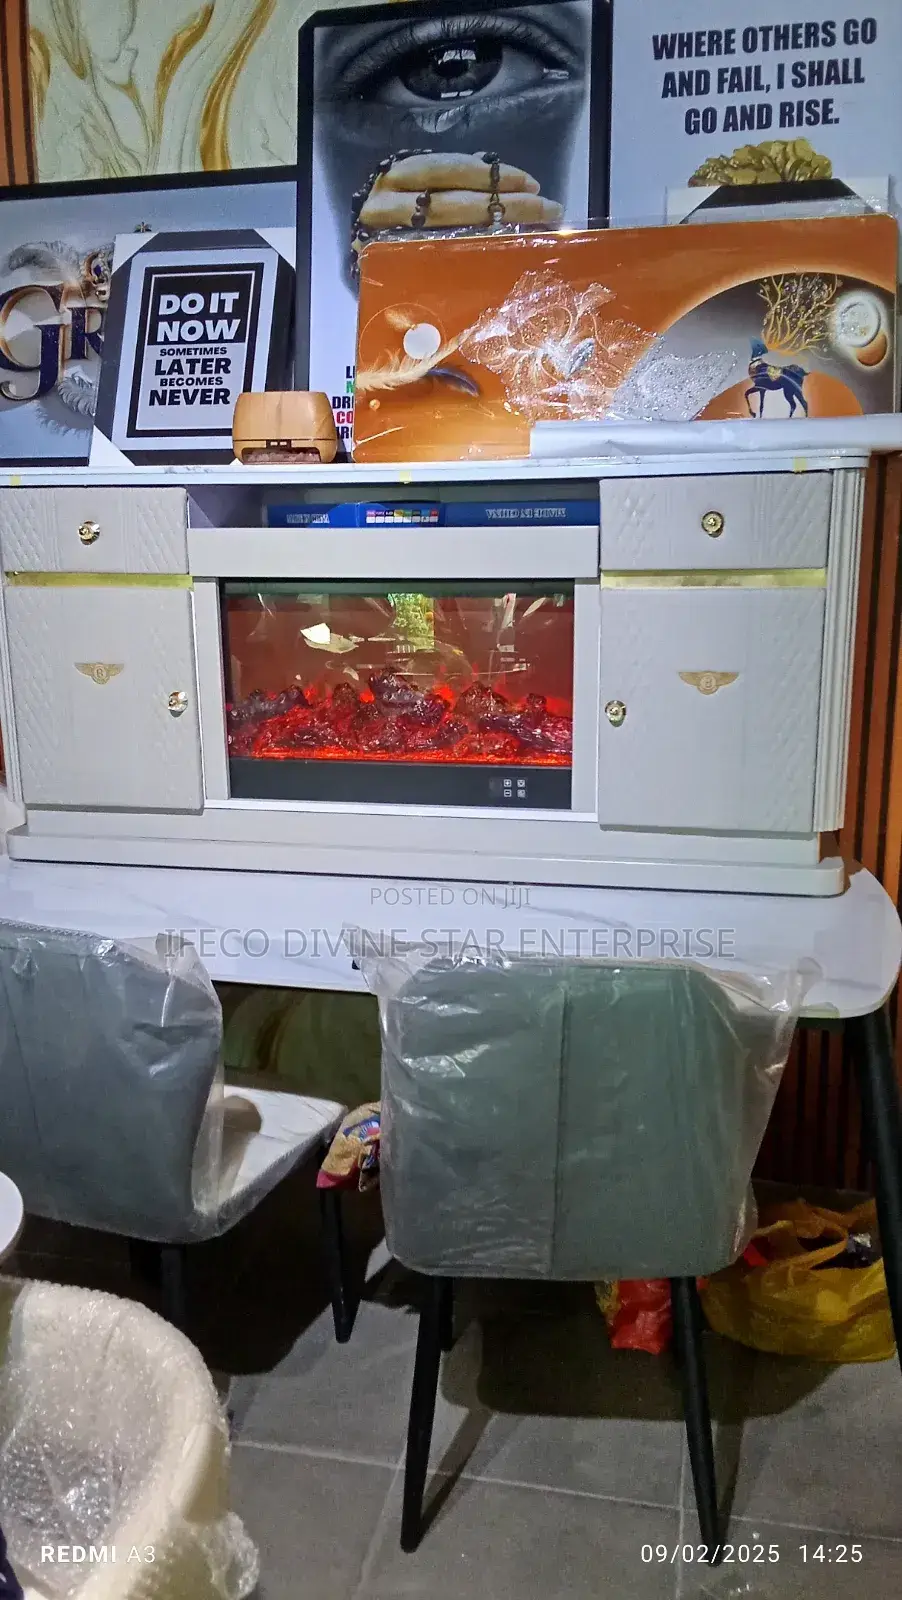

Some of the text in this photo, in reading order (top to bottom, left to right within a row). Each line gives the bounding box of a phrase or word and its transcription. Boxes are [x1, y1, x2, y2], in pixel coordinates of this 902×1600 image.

[652, 17, 877, 60] WHERE OTHERS GO
[662, 57, 865, 98] AND FAIL, I SHALL
[684, 98, 840, 135] GO AND RISE.
[158, 292, 240, 315] DO IT
[156, 319, 241, 342] NOW
[160, 347, 227, 357] SOMETIMES
[154, 357, 232, 376] LATER
[159, 376, 224, 387] BECOMES
[148, 388, 231, 406] NEVER
